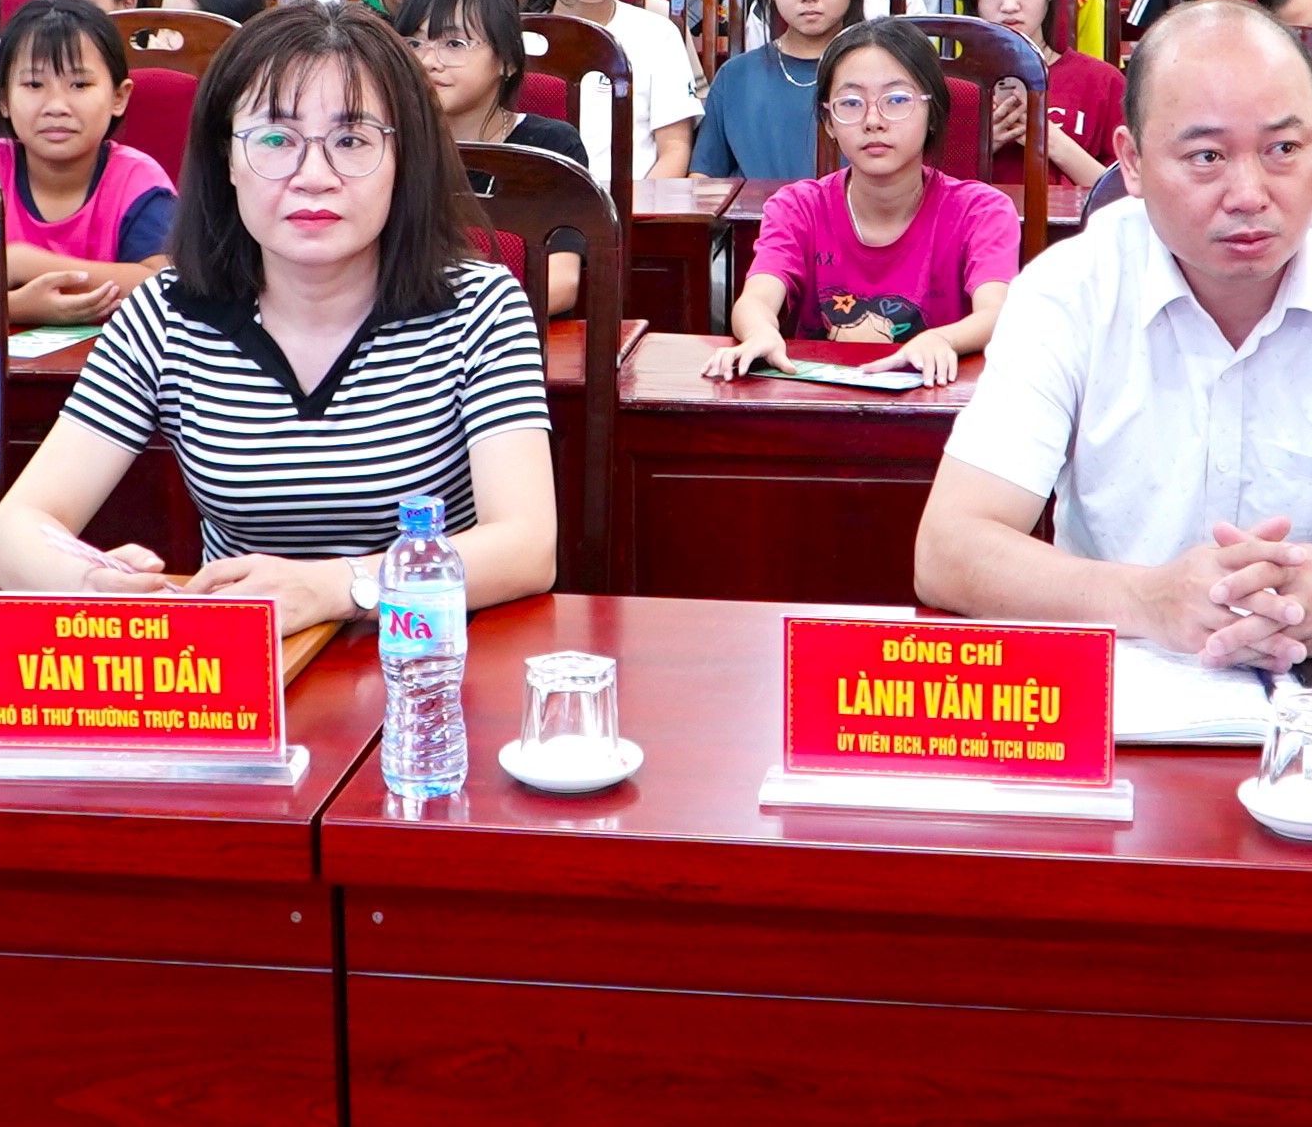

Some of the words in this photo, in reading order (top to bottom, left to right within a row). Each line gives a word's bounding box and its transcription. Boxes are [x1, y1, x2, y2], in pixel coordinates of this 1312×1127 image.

[55, 610, 122, 640] ĐỒNG
[128, 613, 170, 640] CHÍ
[389, 608, 433, 640] Nà
[882, 634, 953, 665] ĐỒNG
[960, 640, 1004, 667] CHÍ
[17, 647, 85, 691] VĂN
[92, 655, 145, 701] THỊ
[153, 645, 222, 694] DẦN
[837, 671, 915, 718] LÀNH
[923, 674, 984, 721] VĂN
[991, 678, 1061, 732] HIỆU
[21, 705, 38, 727] BÍ
[42, 706, 75, 727] THƯ
[76, 705, 140, 728] THƯỜNG
[143, 709, 185, 733] TRỰC
[188, 704, 234, 731] ĐẢNG
[237, 705, 259, 731] ỦY
[837, 725, 857, 752] ỦY
[858, 731, 891, 754] VIÊN
[893, 734, 926, 757] BCH,
[928, 733, 958, 757] PHÓ
[960, 732, 989, 758] CHỦ
[991, 740, 1024, 763] TỊCH
[1026, 740, 1066, 762] UBND
